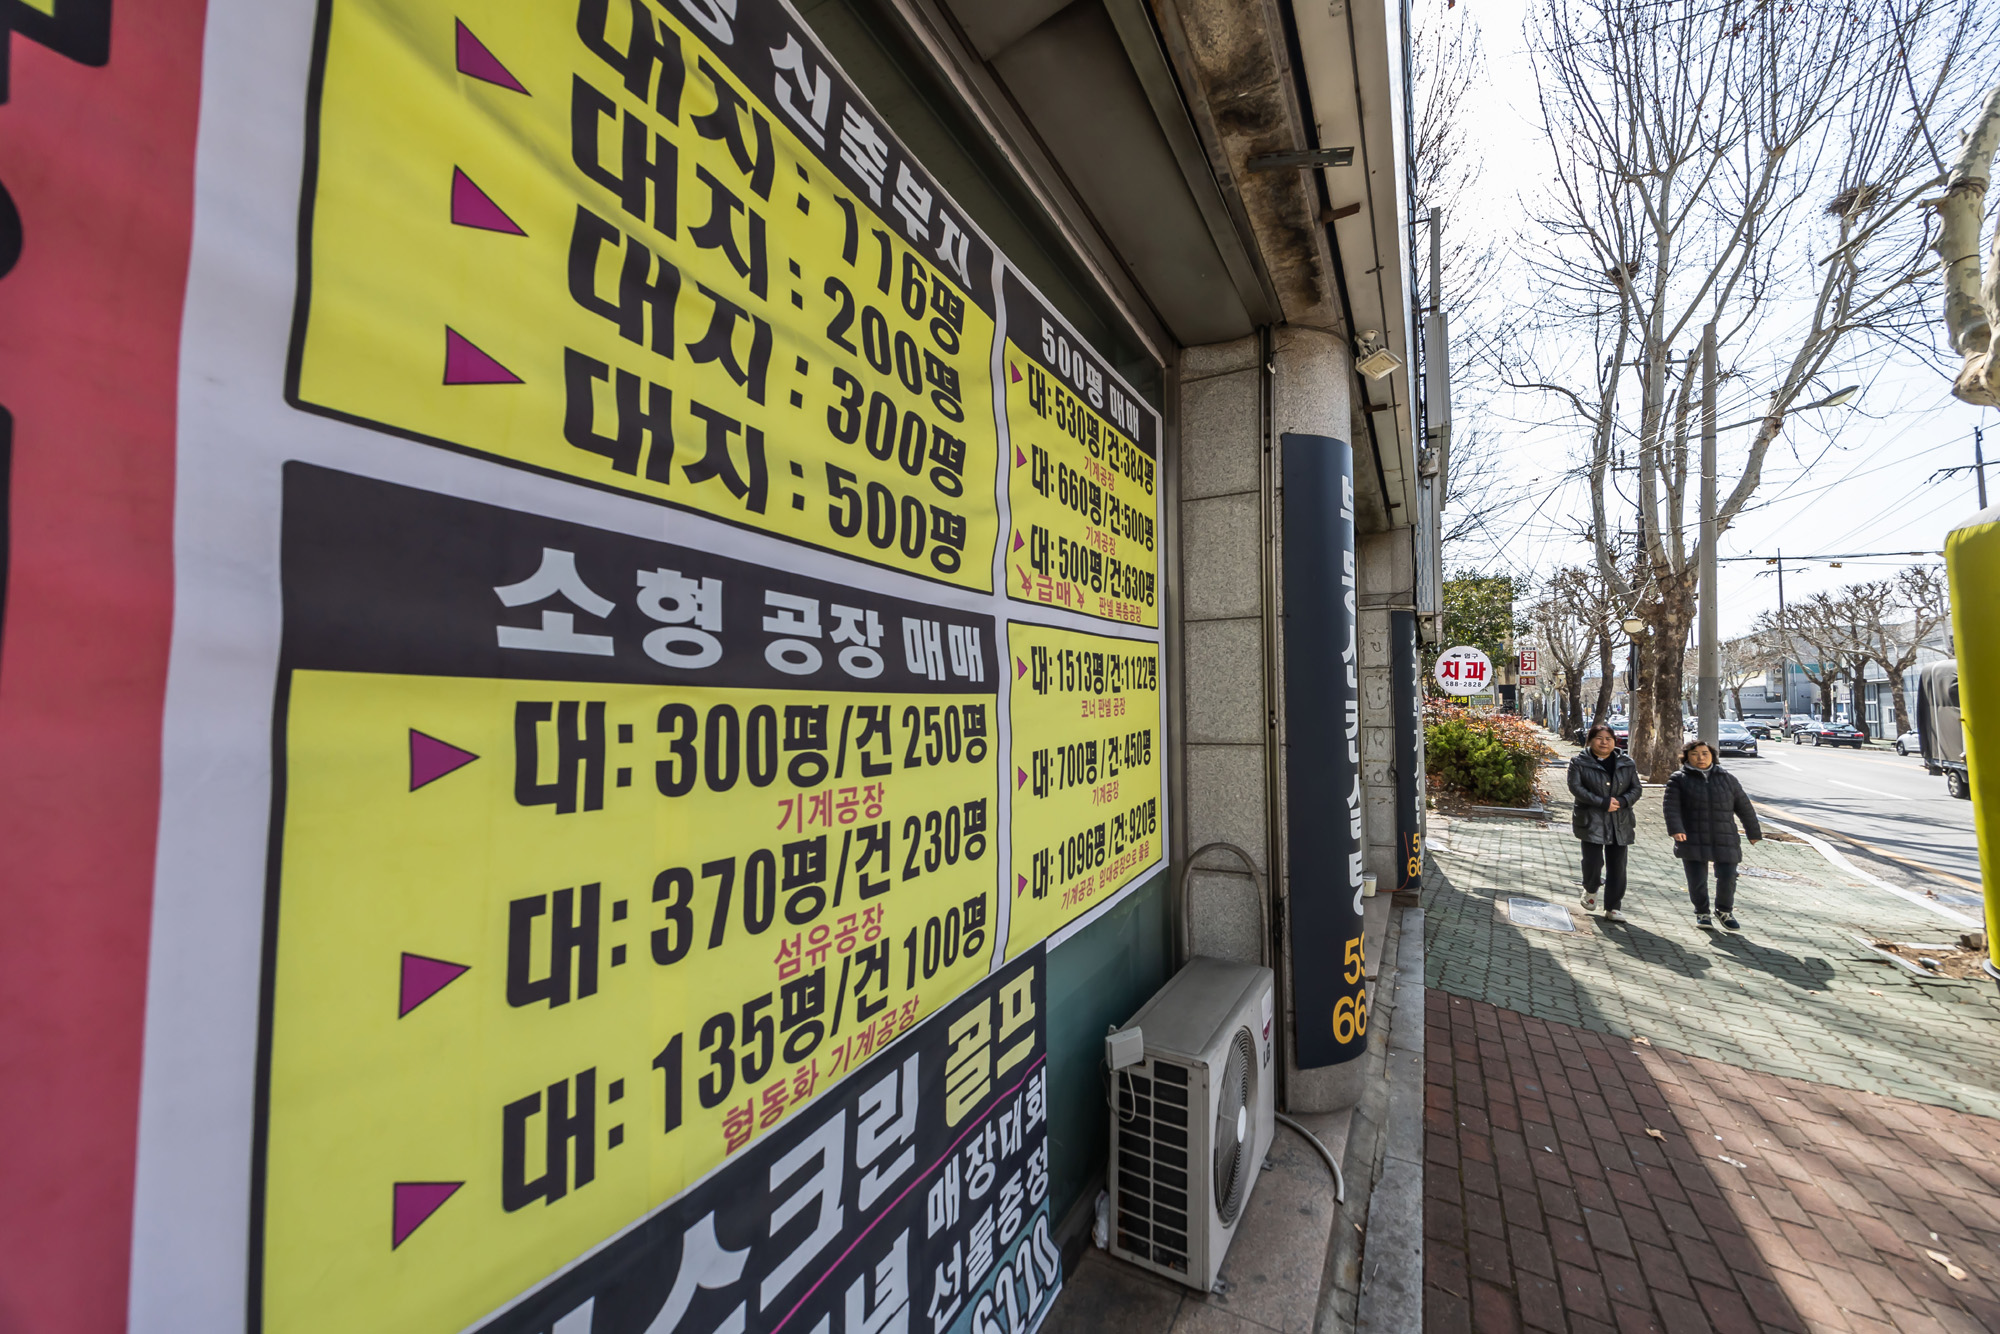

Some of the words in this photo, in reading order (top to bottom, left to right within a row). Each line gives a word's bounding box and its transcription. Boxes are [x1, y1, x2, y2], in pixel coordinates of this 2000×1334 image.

[769, 32, 972, 289] 신축부지
[1041, 317, 1104, 410] 500평
[1109, 384, 1139, 441] 매매
[1084, 456, 1115, 491] 기계공장
[1086, 526, 1116, 556] 기계공장
[493, 547, 723, 669] 소형
[762, 589, 884, 679] 공장
[902, 617, 984, 682] 매매
[1036, 574, 1071, 608] 급매
[1441, 661, 1486, 681] 치과
[1522, 652, 1535, 670] 전기
[903, 704, 987, 769] 250평
[1081, 699, 1096, 718] 코너
[1113, 697, 1125, 717] 공장
[777, 782, 884, 834] 기계공장
[1092, 780, 1119, 806] 기계공장
[902, 798, 987, 882] 230평
[774, 903, 884, 981] 섬유공장
[903, 892, 986, 989] 100평
[945, 966, 1036, 1128] 골프
[1263, 1042, 1270, 1070] LG
[722, 1059, 819, 1158] 협동화
[828, 995, 919, 1077] 기계공장
